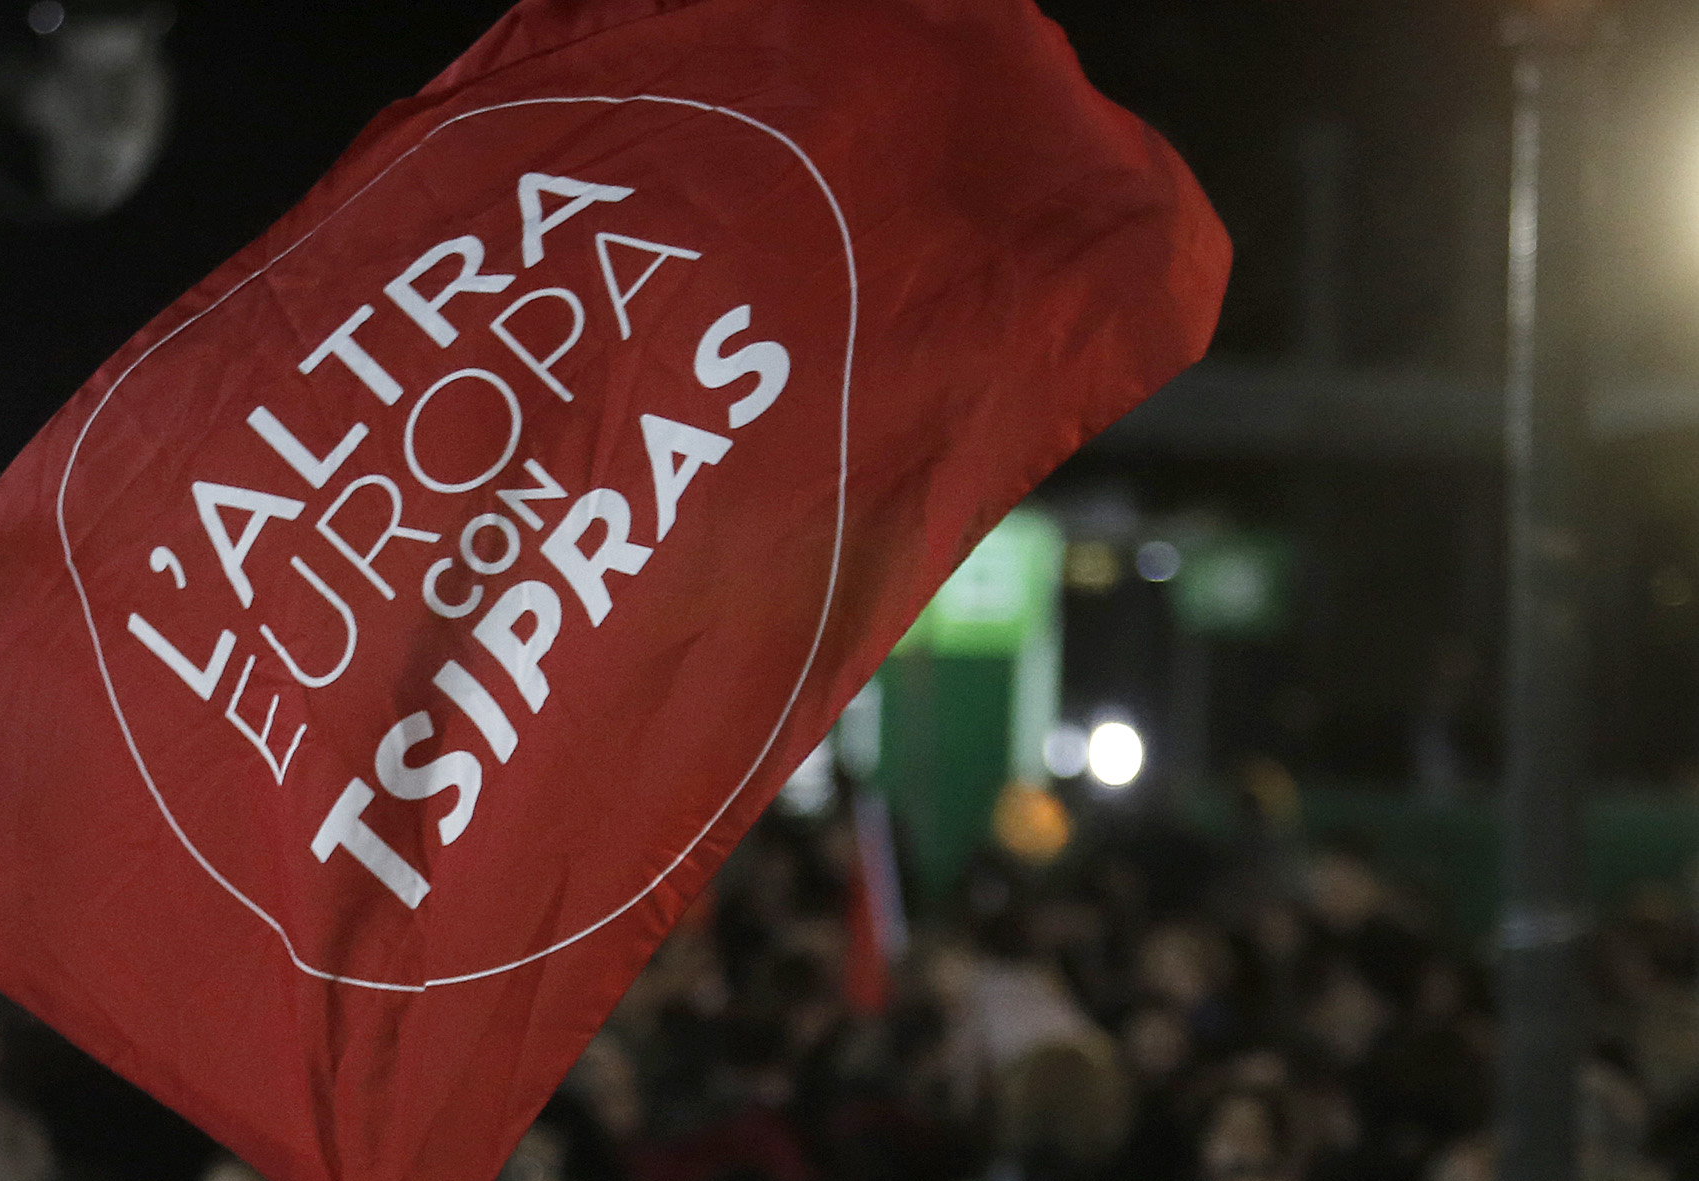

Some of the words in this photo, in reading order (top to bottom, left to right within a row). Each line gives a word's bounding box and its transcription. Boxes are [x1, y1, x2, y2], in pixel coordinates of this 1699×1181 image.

[128, 172, 634, 701] L'ALTRA
[224, 232, 702, 786] EUROPA
[309, 304, 791, 910] TSIPRAS
[421, 458, 569, 619] CON
